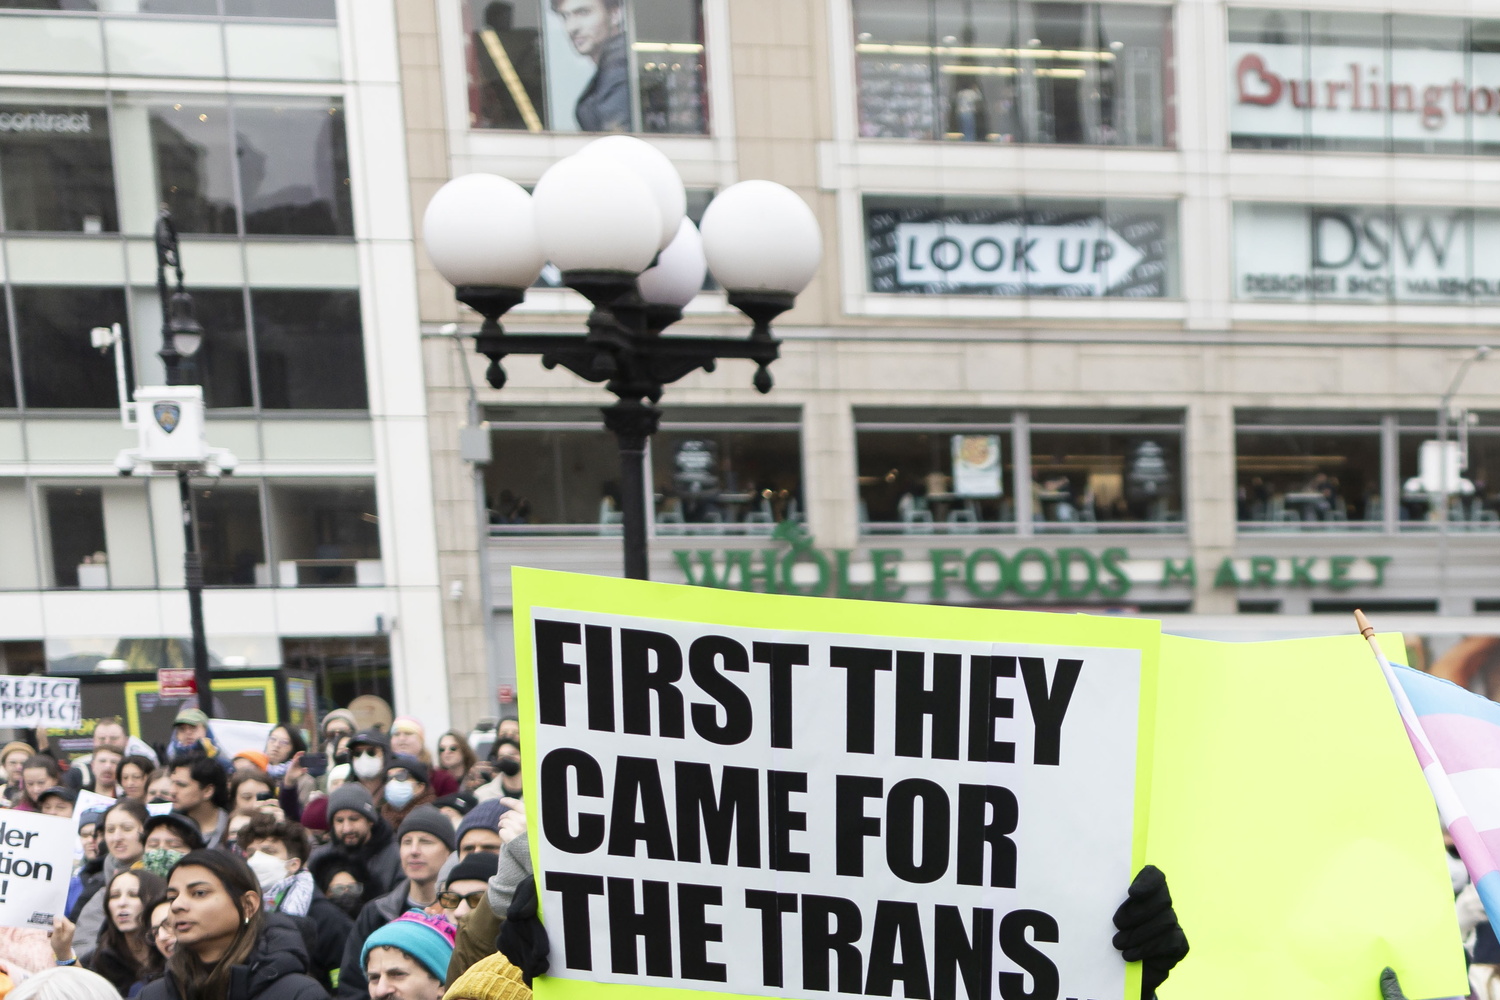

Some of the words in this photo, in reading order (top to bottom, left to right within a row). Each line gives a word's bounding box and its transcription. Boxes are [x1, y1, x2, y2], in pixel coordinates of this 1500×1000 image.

[907, 236, 1040, 273] LOOK
[1057, 238, 1116, 274] UP
[1310, 209, 1463, 271] DSW
[673, 549, 904, 599] WHOLE
[929, 548, 1133, 600] FOODS
[1159, 555, 1393, 590] MARKET
[534, 618, 810, 750] FIRST
[829, 646, 1084, 766] THEY
[0, 822, 39, 849] er
[540, 746, 811, 873] CAME
[835, 774, 1019, 889] FOR
[545, 871, 728, 983] THE
